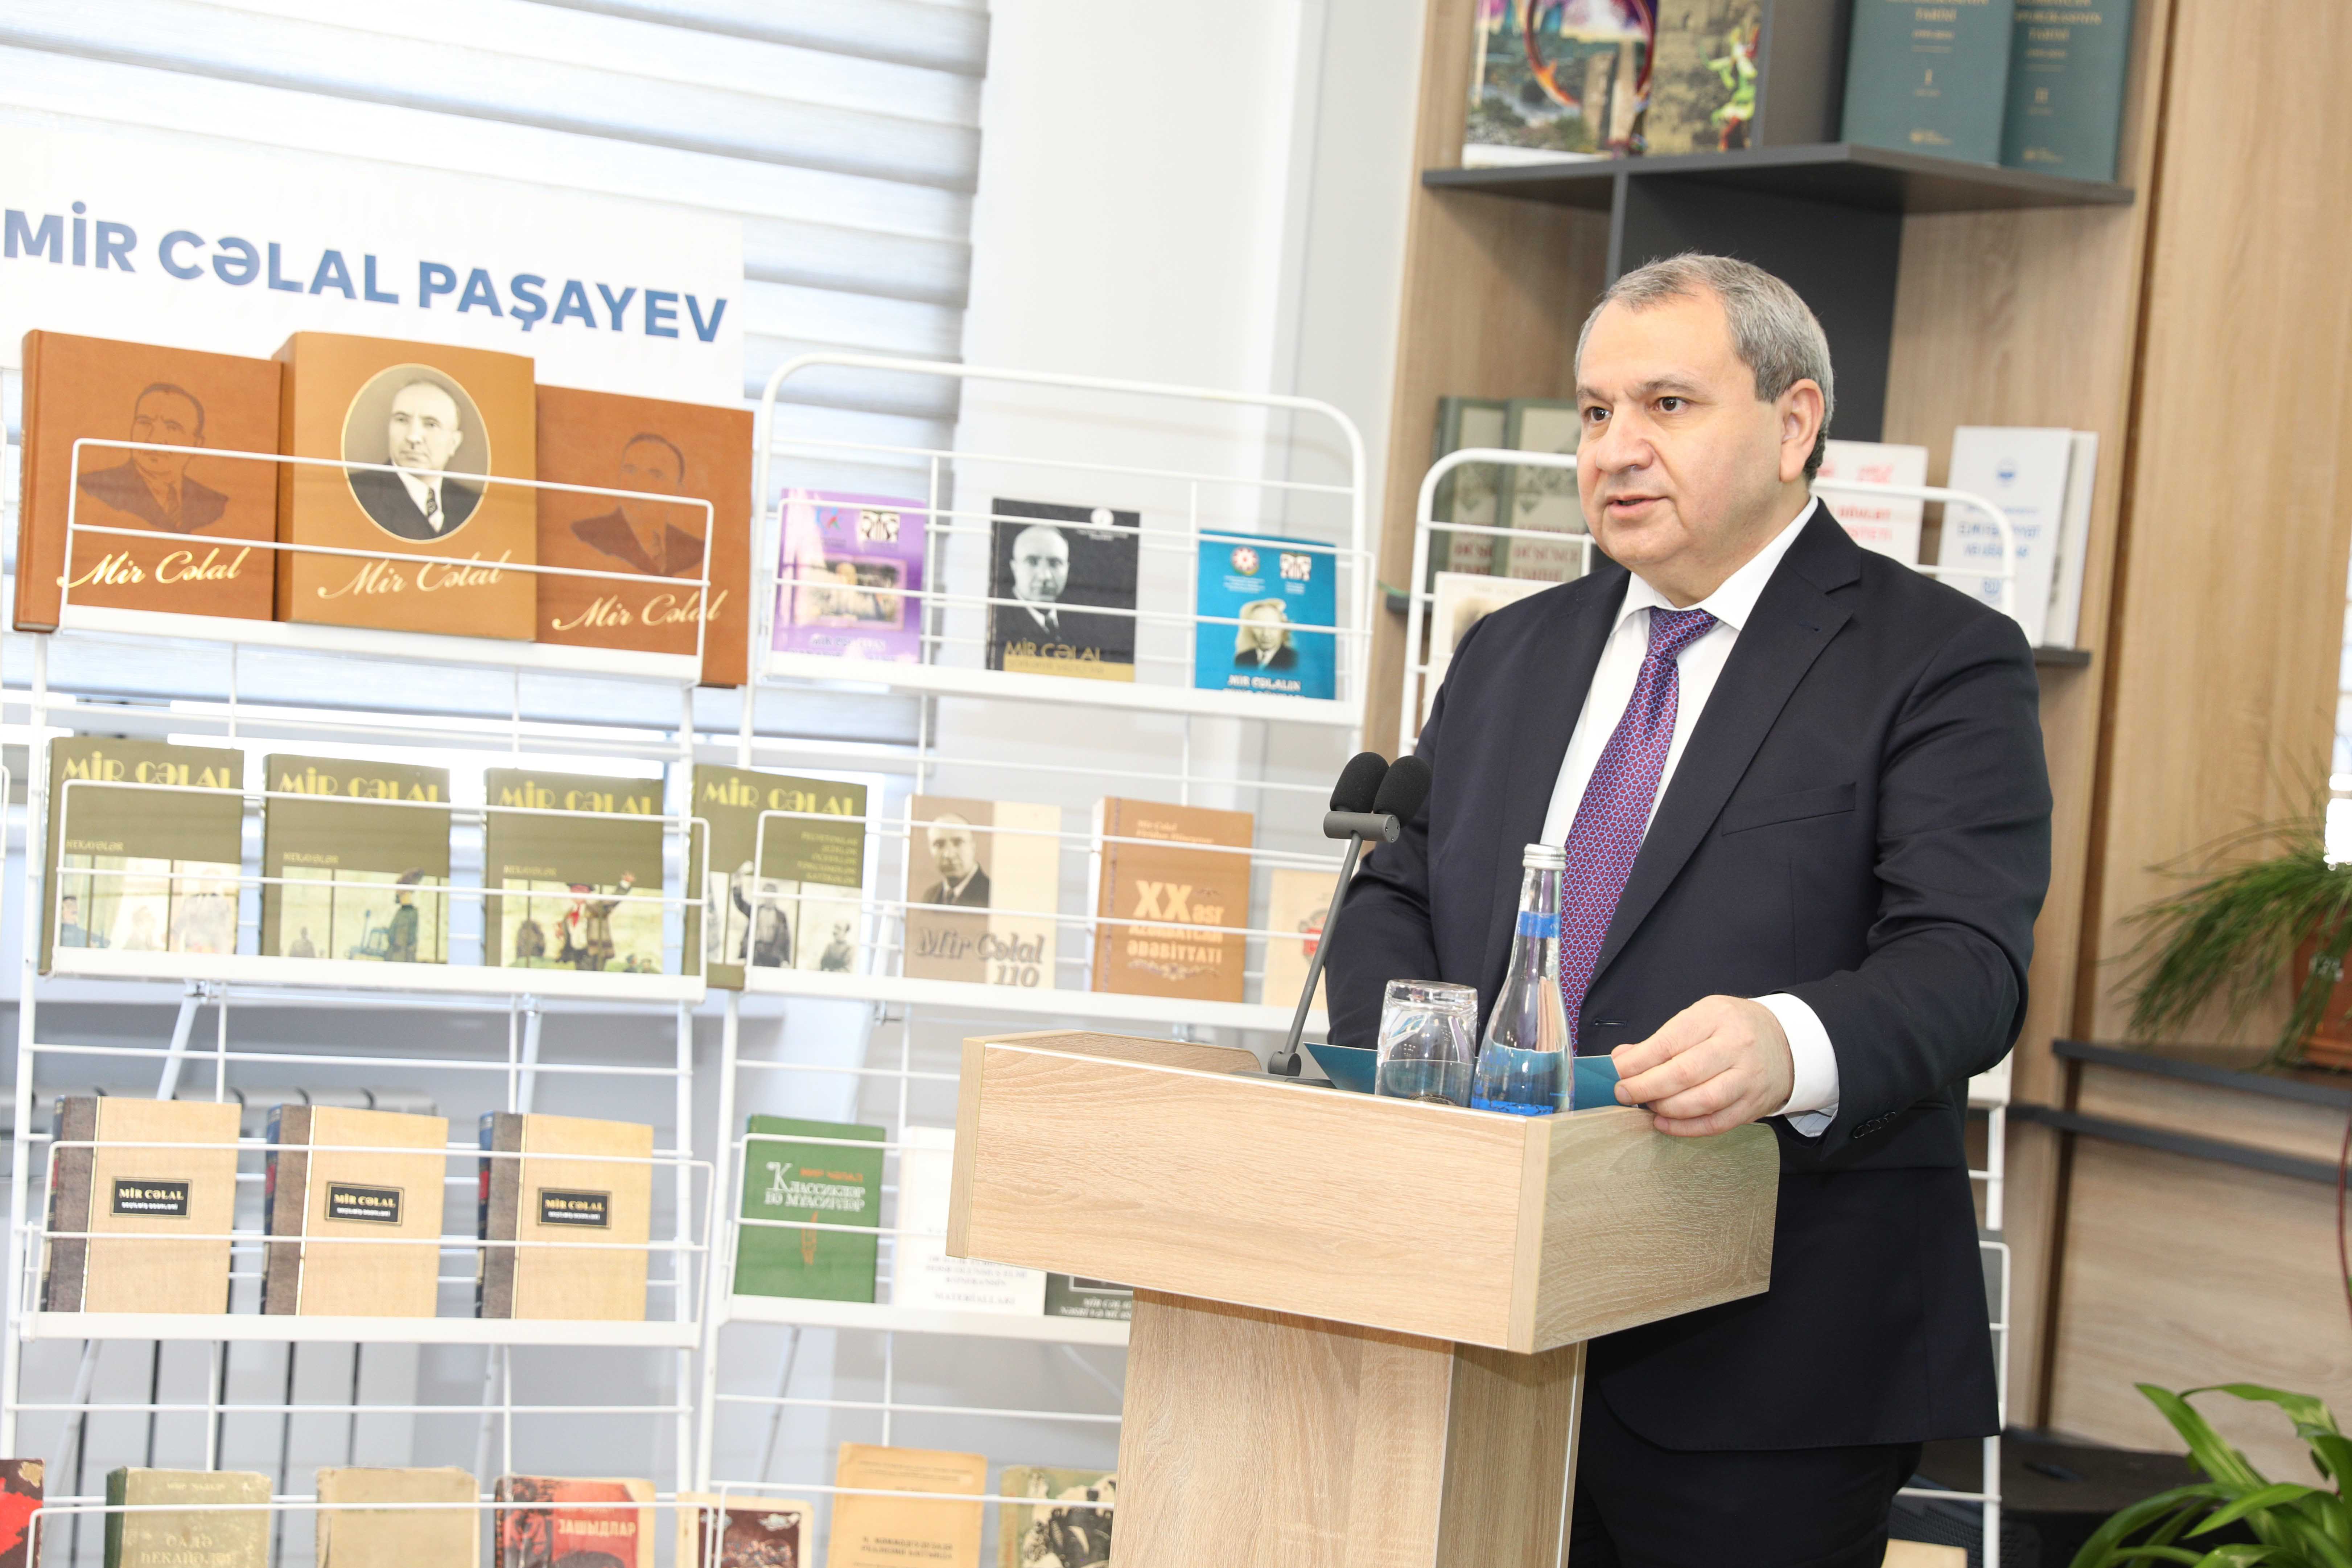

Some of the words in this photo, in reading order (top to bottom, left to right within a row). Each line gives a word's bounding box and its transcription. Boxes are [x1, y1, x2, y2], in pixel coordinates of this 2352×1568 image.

[4, 201, 137, 273] MİR
[158, 230, 399, 304] CƏLAL
[419, 260, 728, 342] PAŞAYEV
[56, 551, 146, 588] Mir
[317, 558, 407, 599] Mir
[552, 595, 634, 631] Mir
[1005, 637, 1037, 657] MİR
[61, 750, 125, 781] MİR
[278, 767, 338, 795] MİR
[497, 780, 556, 808] MİR
[703, 777, 759, 808] MİR
[1133, 880, 1193, 922] XX
[915, 927, 971, 960] Mir
[994, 964, 1040, 988] 110
[119, 1187, 143, 1199] MİR
[334, 1193, 357, 1205] MİR
[545, 1198, 567, 1210] MİR
